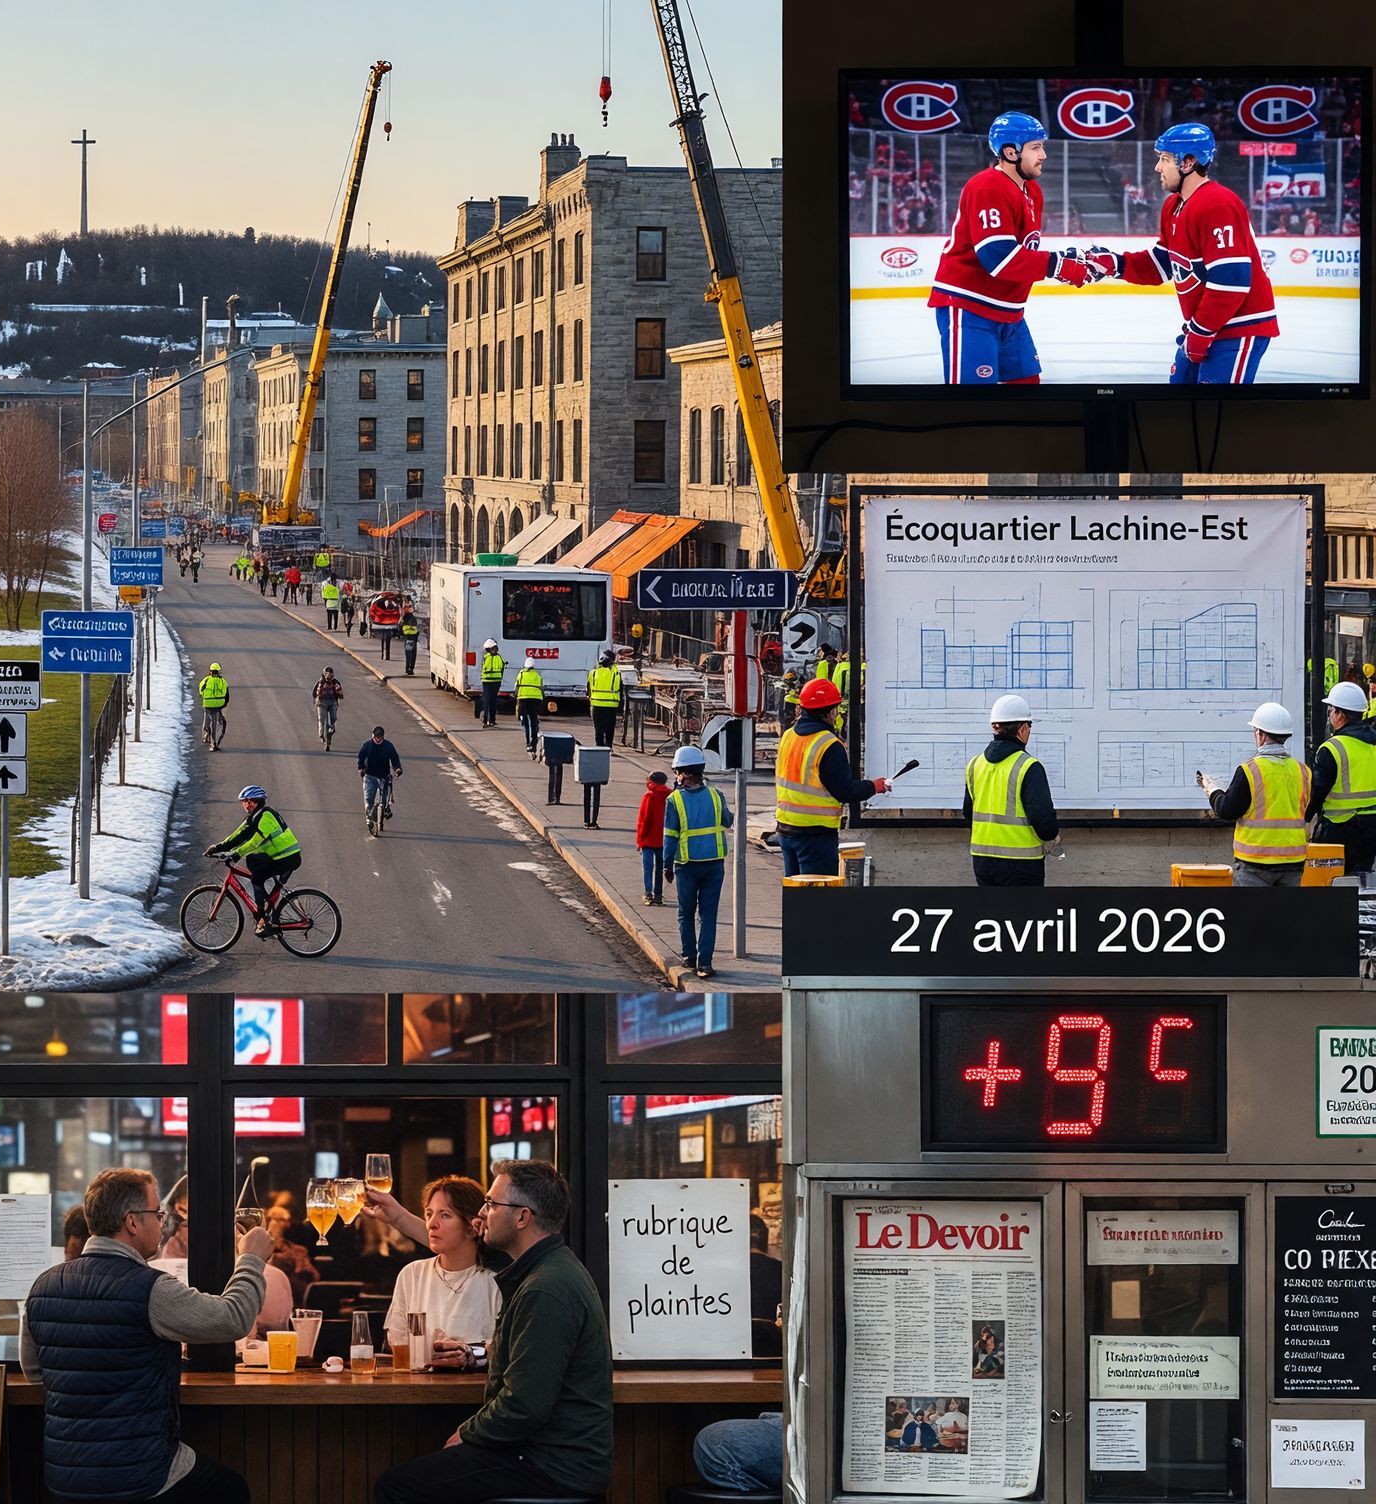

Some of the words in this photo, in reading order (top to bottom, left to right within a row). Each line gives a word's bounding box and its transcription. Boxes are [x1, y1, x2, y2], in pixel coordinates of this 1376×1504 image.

[886, 508, 1061, 547] Écoquartier
[1070, 514, 1249, 541] Lachine-Est
[622, 1204, 733, 1249] rubrique
[855, 1212, 903, 1250] Le
[907, 1212, 1030, 1251] Devoir
[660, 1244, 695, 1276] de
[627, 1283, 733, 1334] plaintes
